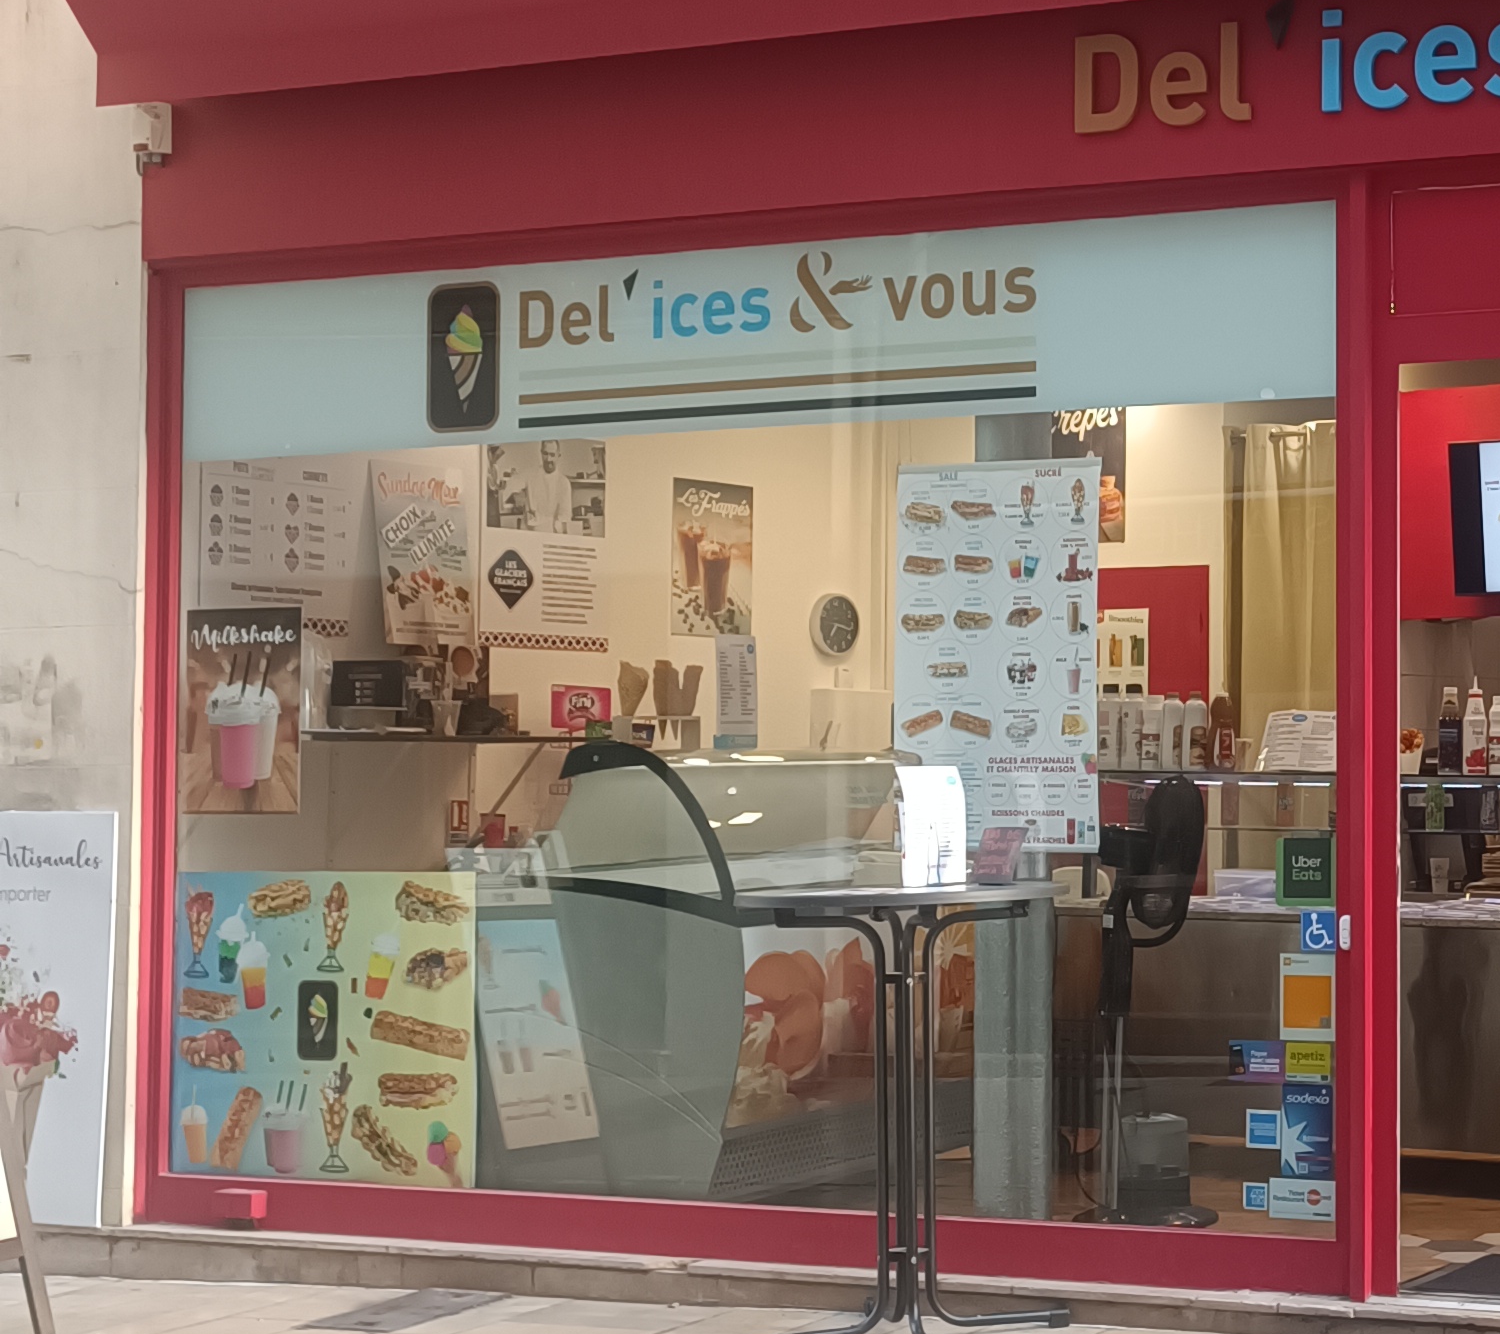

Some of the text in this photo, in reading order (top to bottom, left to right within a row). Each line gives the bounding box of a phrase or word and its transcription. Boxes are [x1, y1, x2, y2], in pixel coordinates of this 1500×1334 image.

[789, 251, 872, 332] &
[883, 267, 1037, 321] vous
[384, 506, 420, 544] CHOIX
[190, 623, 296, 653] Milkshake
[1020, 756, 1075, 764] ARTISANALES
[1041, 765, 1077, 773] MAISON
[1292, 855, 1322, 867] Uber
[1292, 869, 1322, 880] Eats
[1289, 1050, 1326, 1063] apetiz
[1285, 1092, 1330, 1105] sodexo
